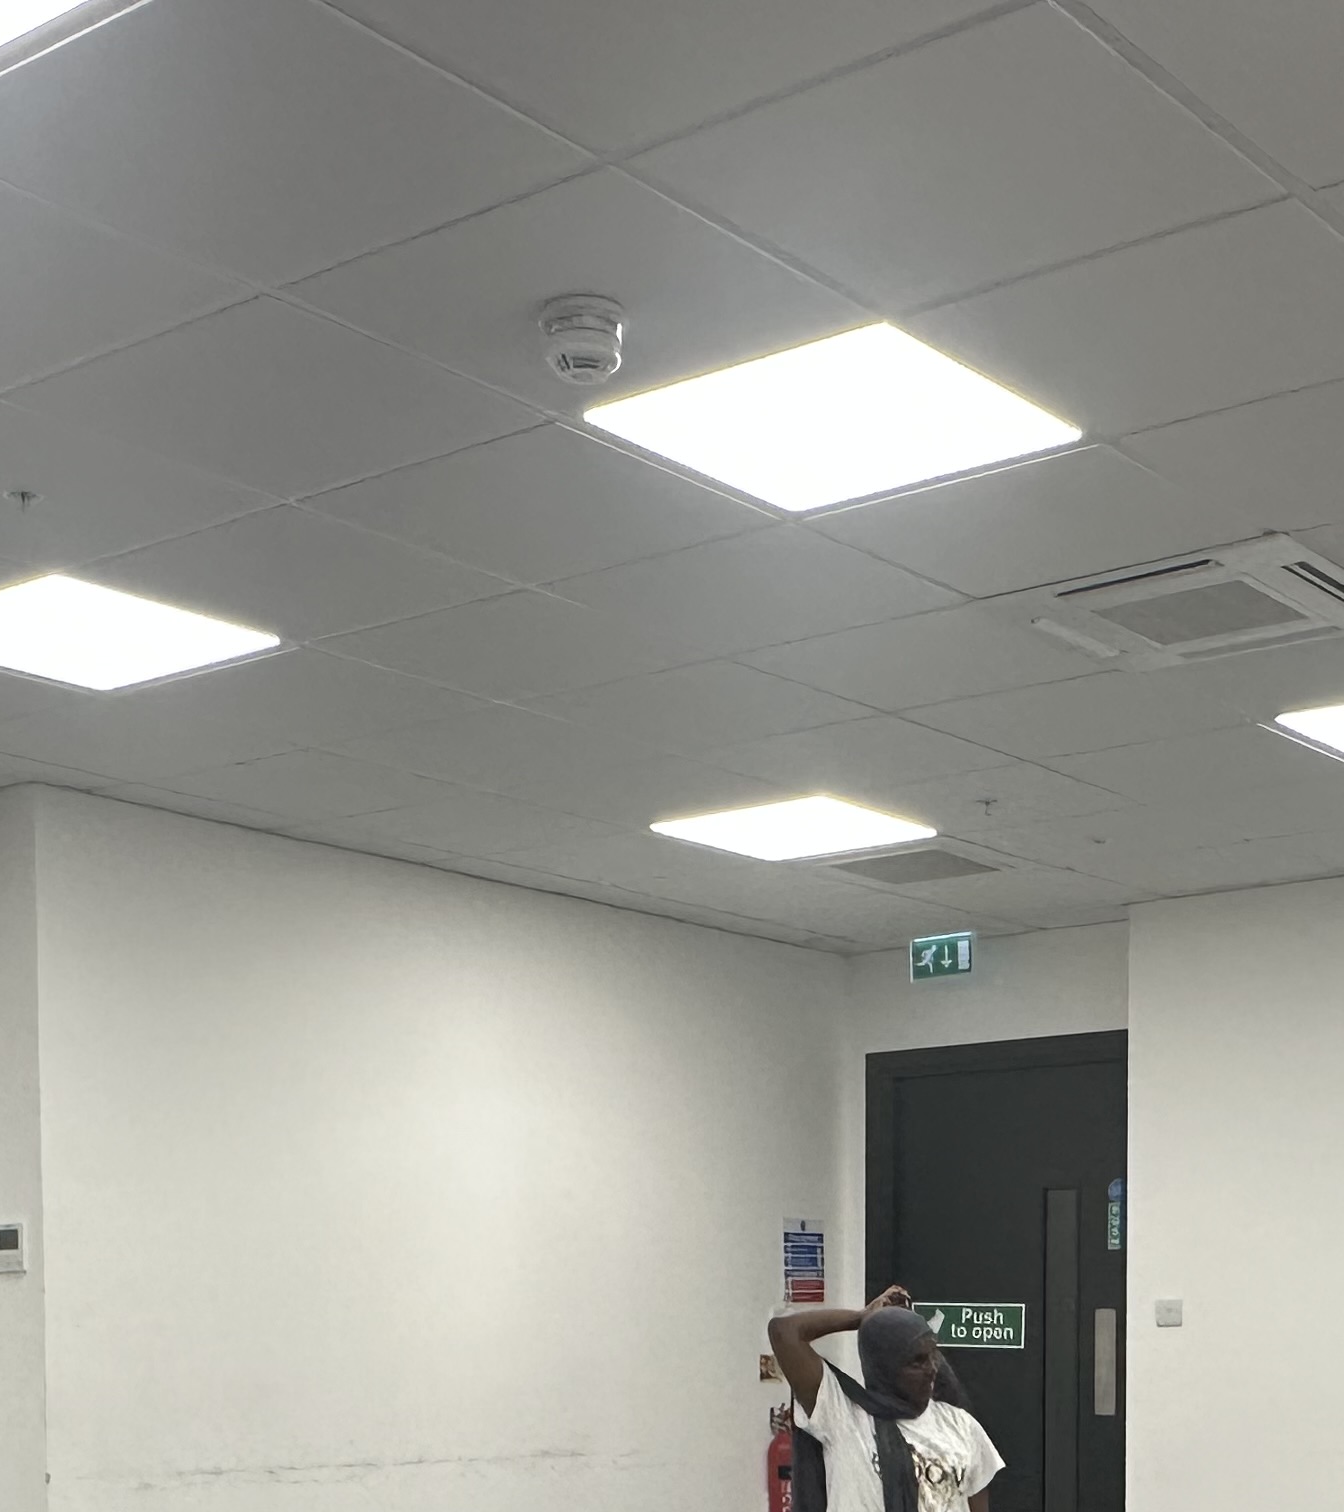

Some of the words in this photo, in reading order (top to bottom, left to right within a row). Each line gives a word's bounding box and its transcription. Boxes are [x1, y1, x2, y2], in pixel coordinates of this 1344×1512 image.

[961, 1307, 1004, 1325] Push
[951, 1323, 967, 1338] to
[972, 1326, 1014, 1342] open
